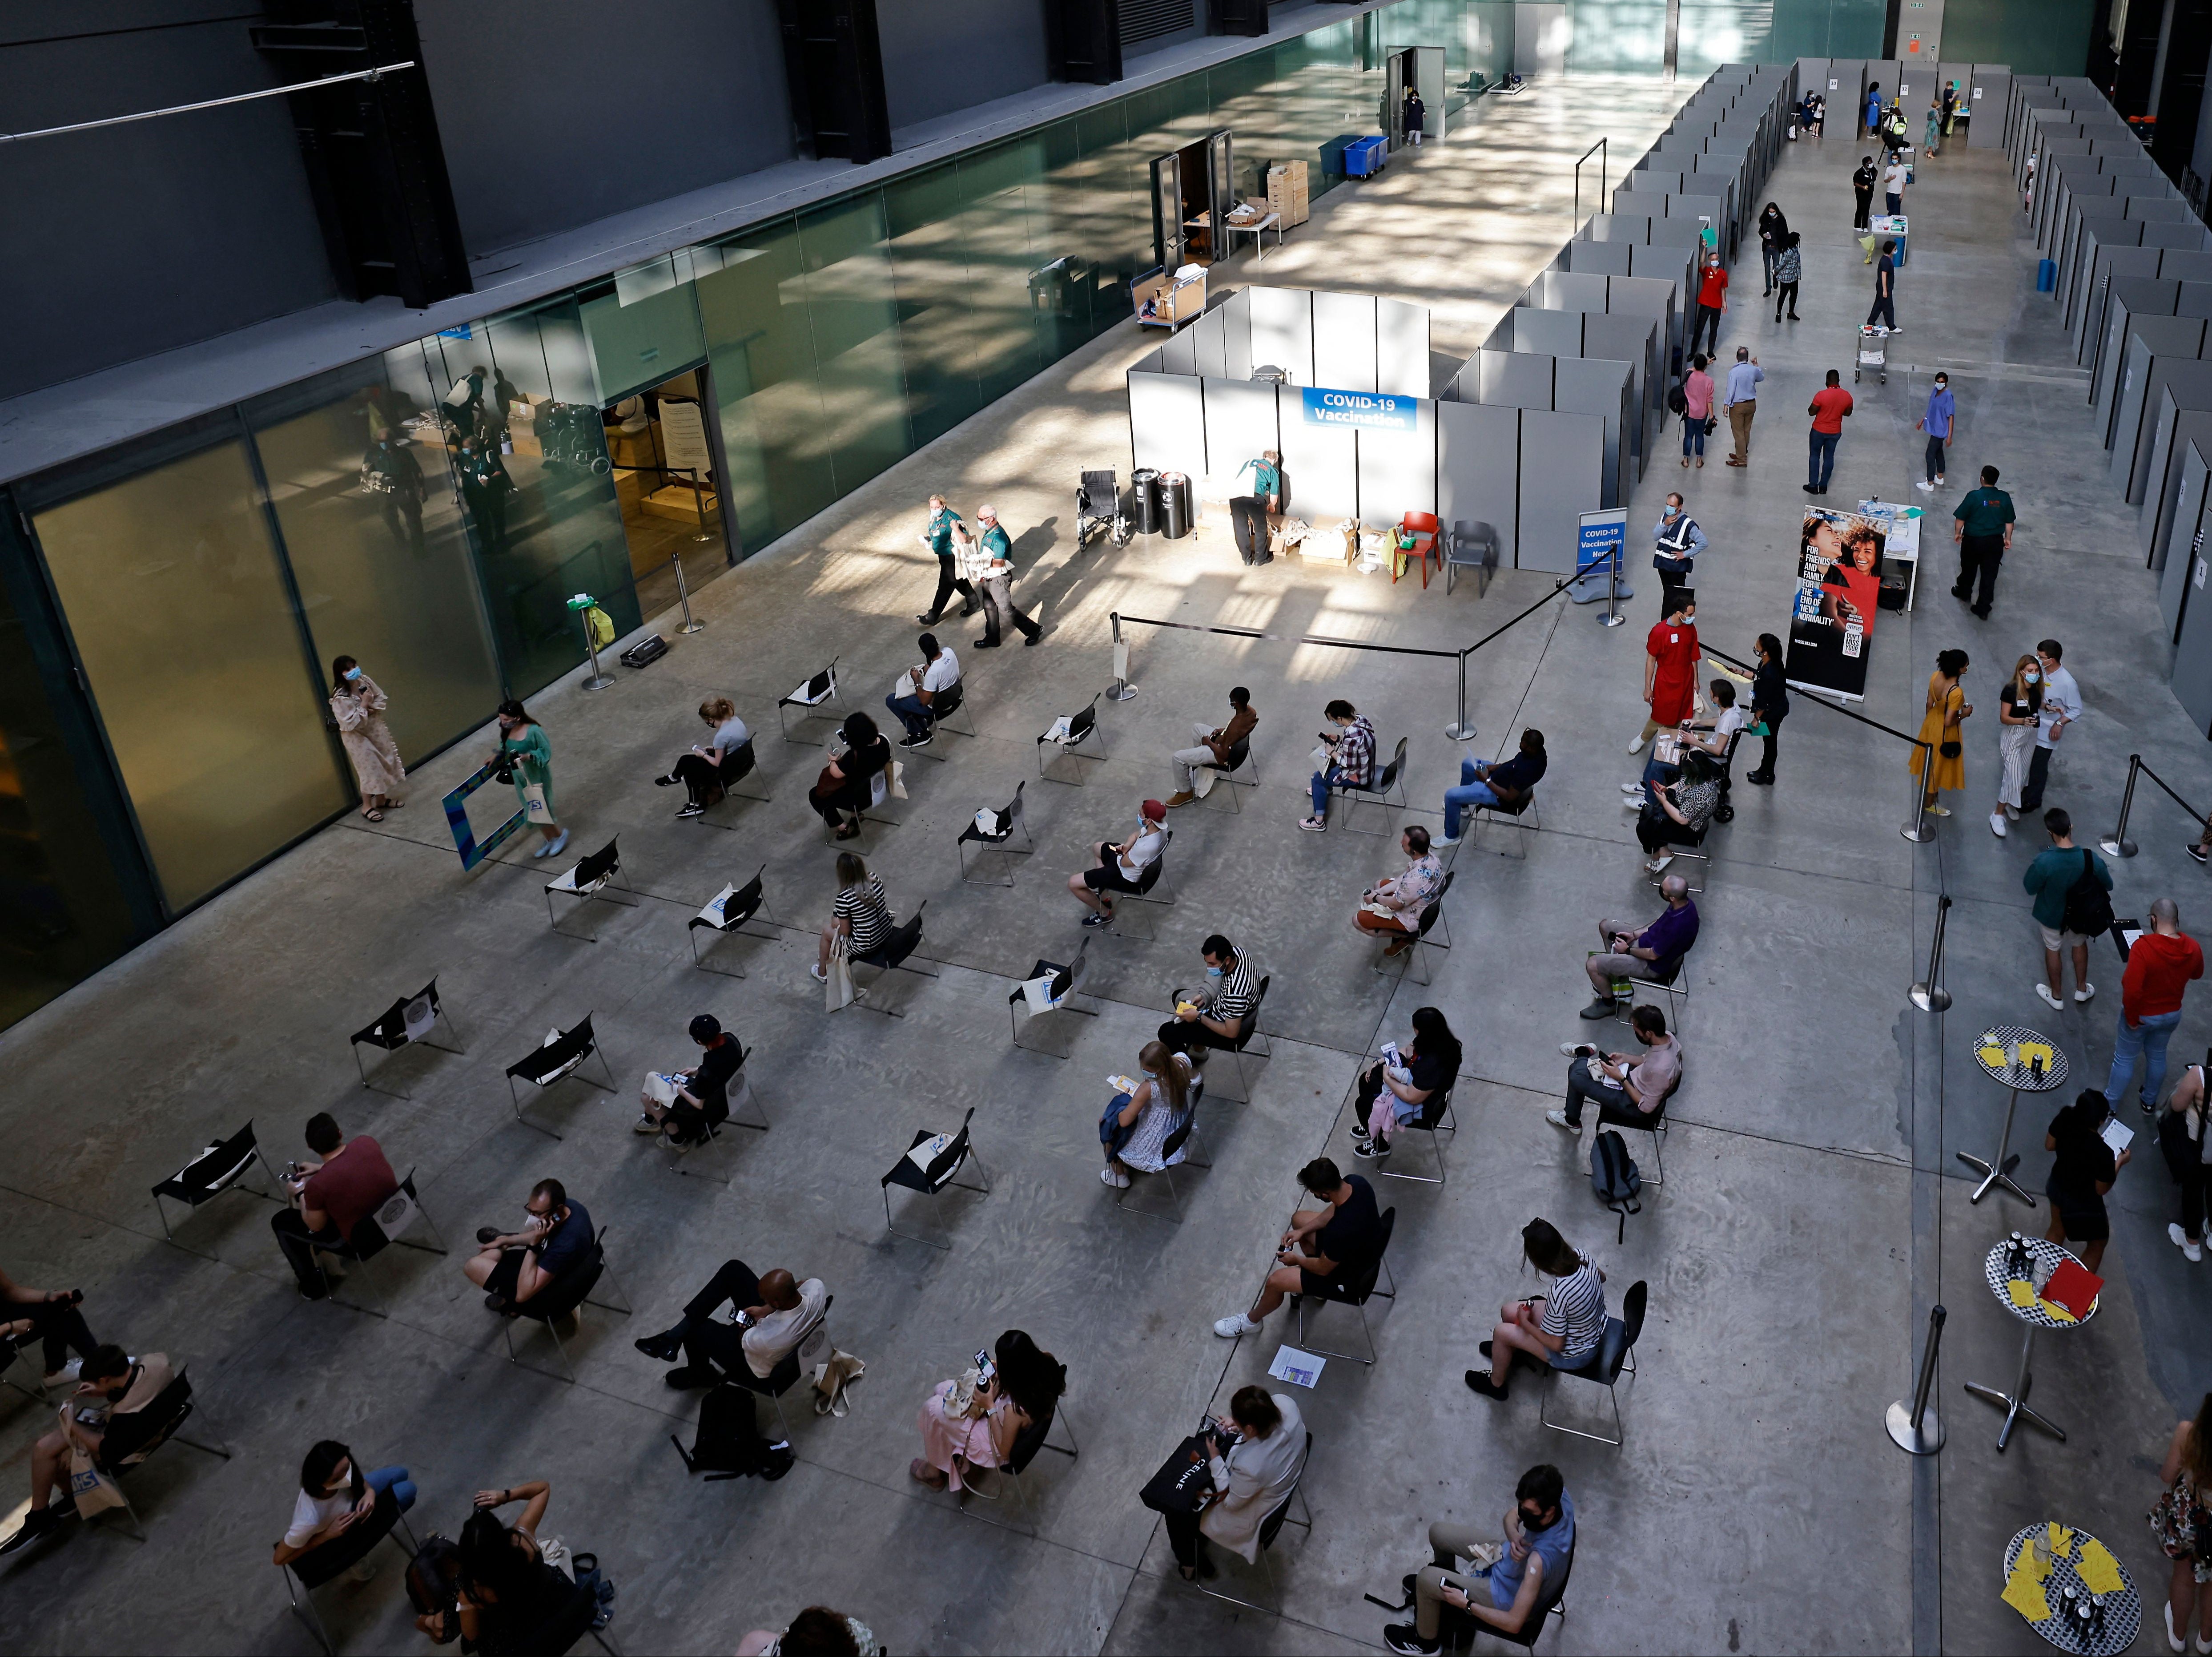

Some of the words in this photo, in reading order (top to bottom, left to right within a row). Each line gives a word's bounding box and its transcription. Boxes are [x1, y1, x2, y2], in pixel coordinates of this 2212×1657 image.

[1323, 394, 1395, 411] COVID-19
[1315, 408, 1405, 428] Vaccination
[1585, 528, 1618, 537] COVID-19
[1806, 545, 1818, 555] FOR
[1806, 554, 1830, 565] FRIENDS
[1804, 562, 1817, 572] AND
[1802, 579, 1814, 588] FOR
[1802, 587, 1813, 597] THE
[1800, 595, 1812, 605] END
[1813, 598, 1821, 606] OF
[1846, 638, 1859, 646] MISS
[1846, 644, 1858, 652] YOUR
[1176, 1459, 1206, 1490] CELINE
[71, 1472, 96, 1492] HS
